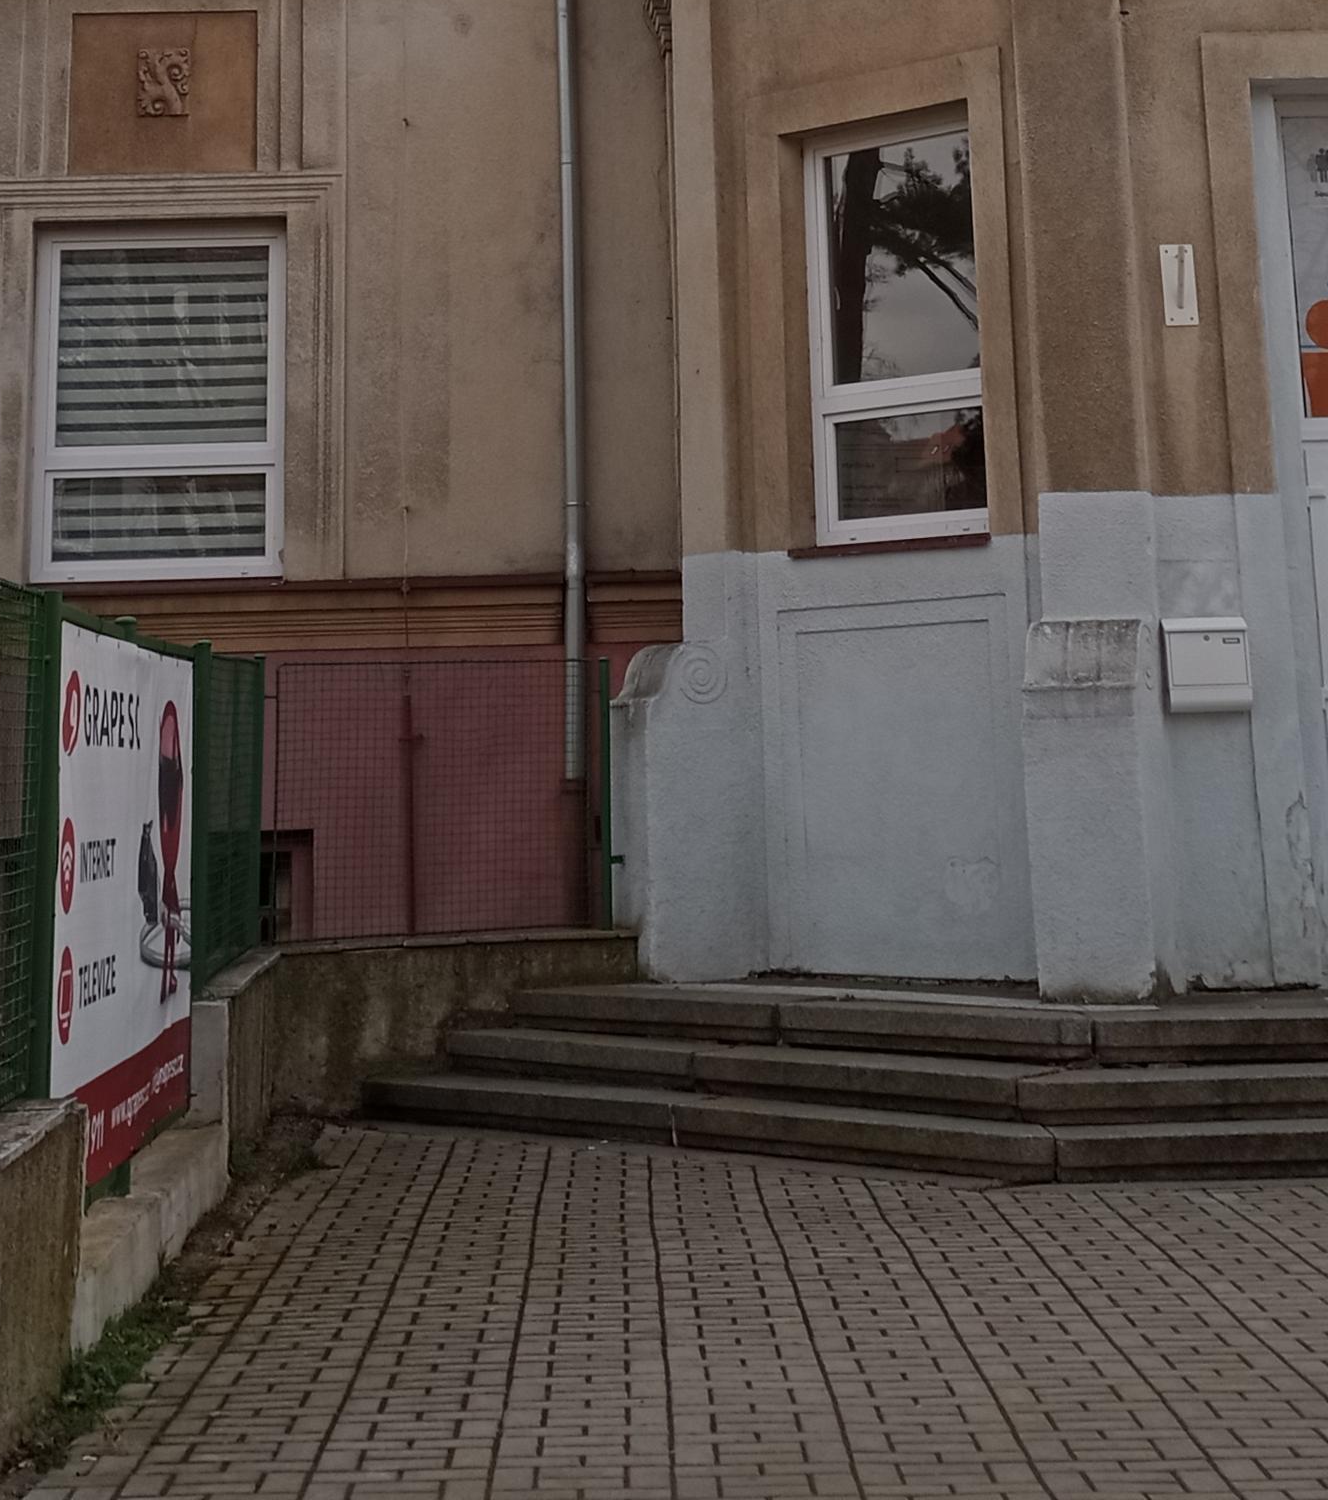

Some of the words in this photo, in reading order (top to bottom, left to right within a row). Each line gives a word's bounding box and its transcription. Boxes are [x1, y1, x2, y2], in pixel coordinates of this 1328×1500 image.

[84, 684, 124, 748] GRAPE
[80, 838, 116, 883] INTERNET
[79, 954, 116, 1010] TELEVIZE
